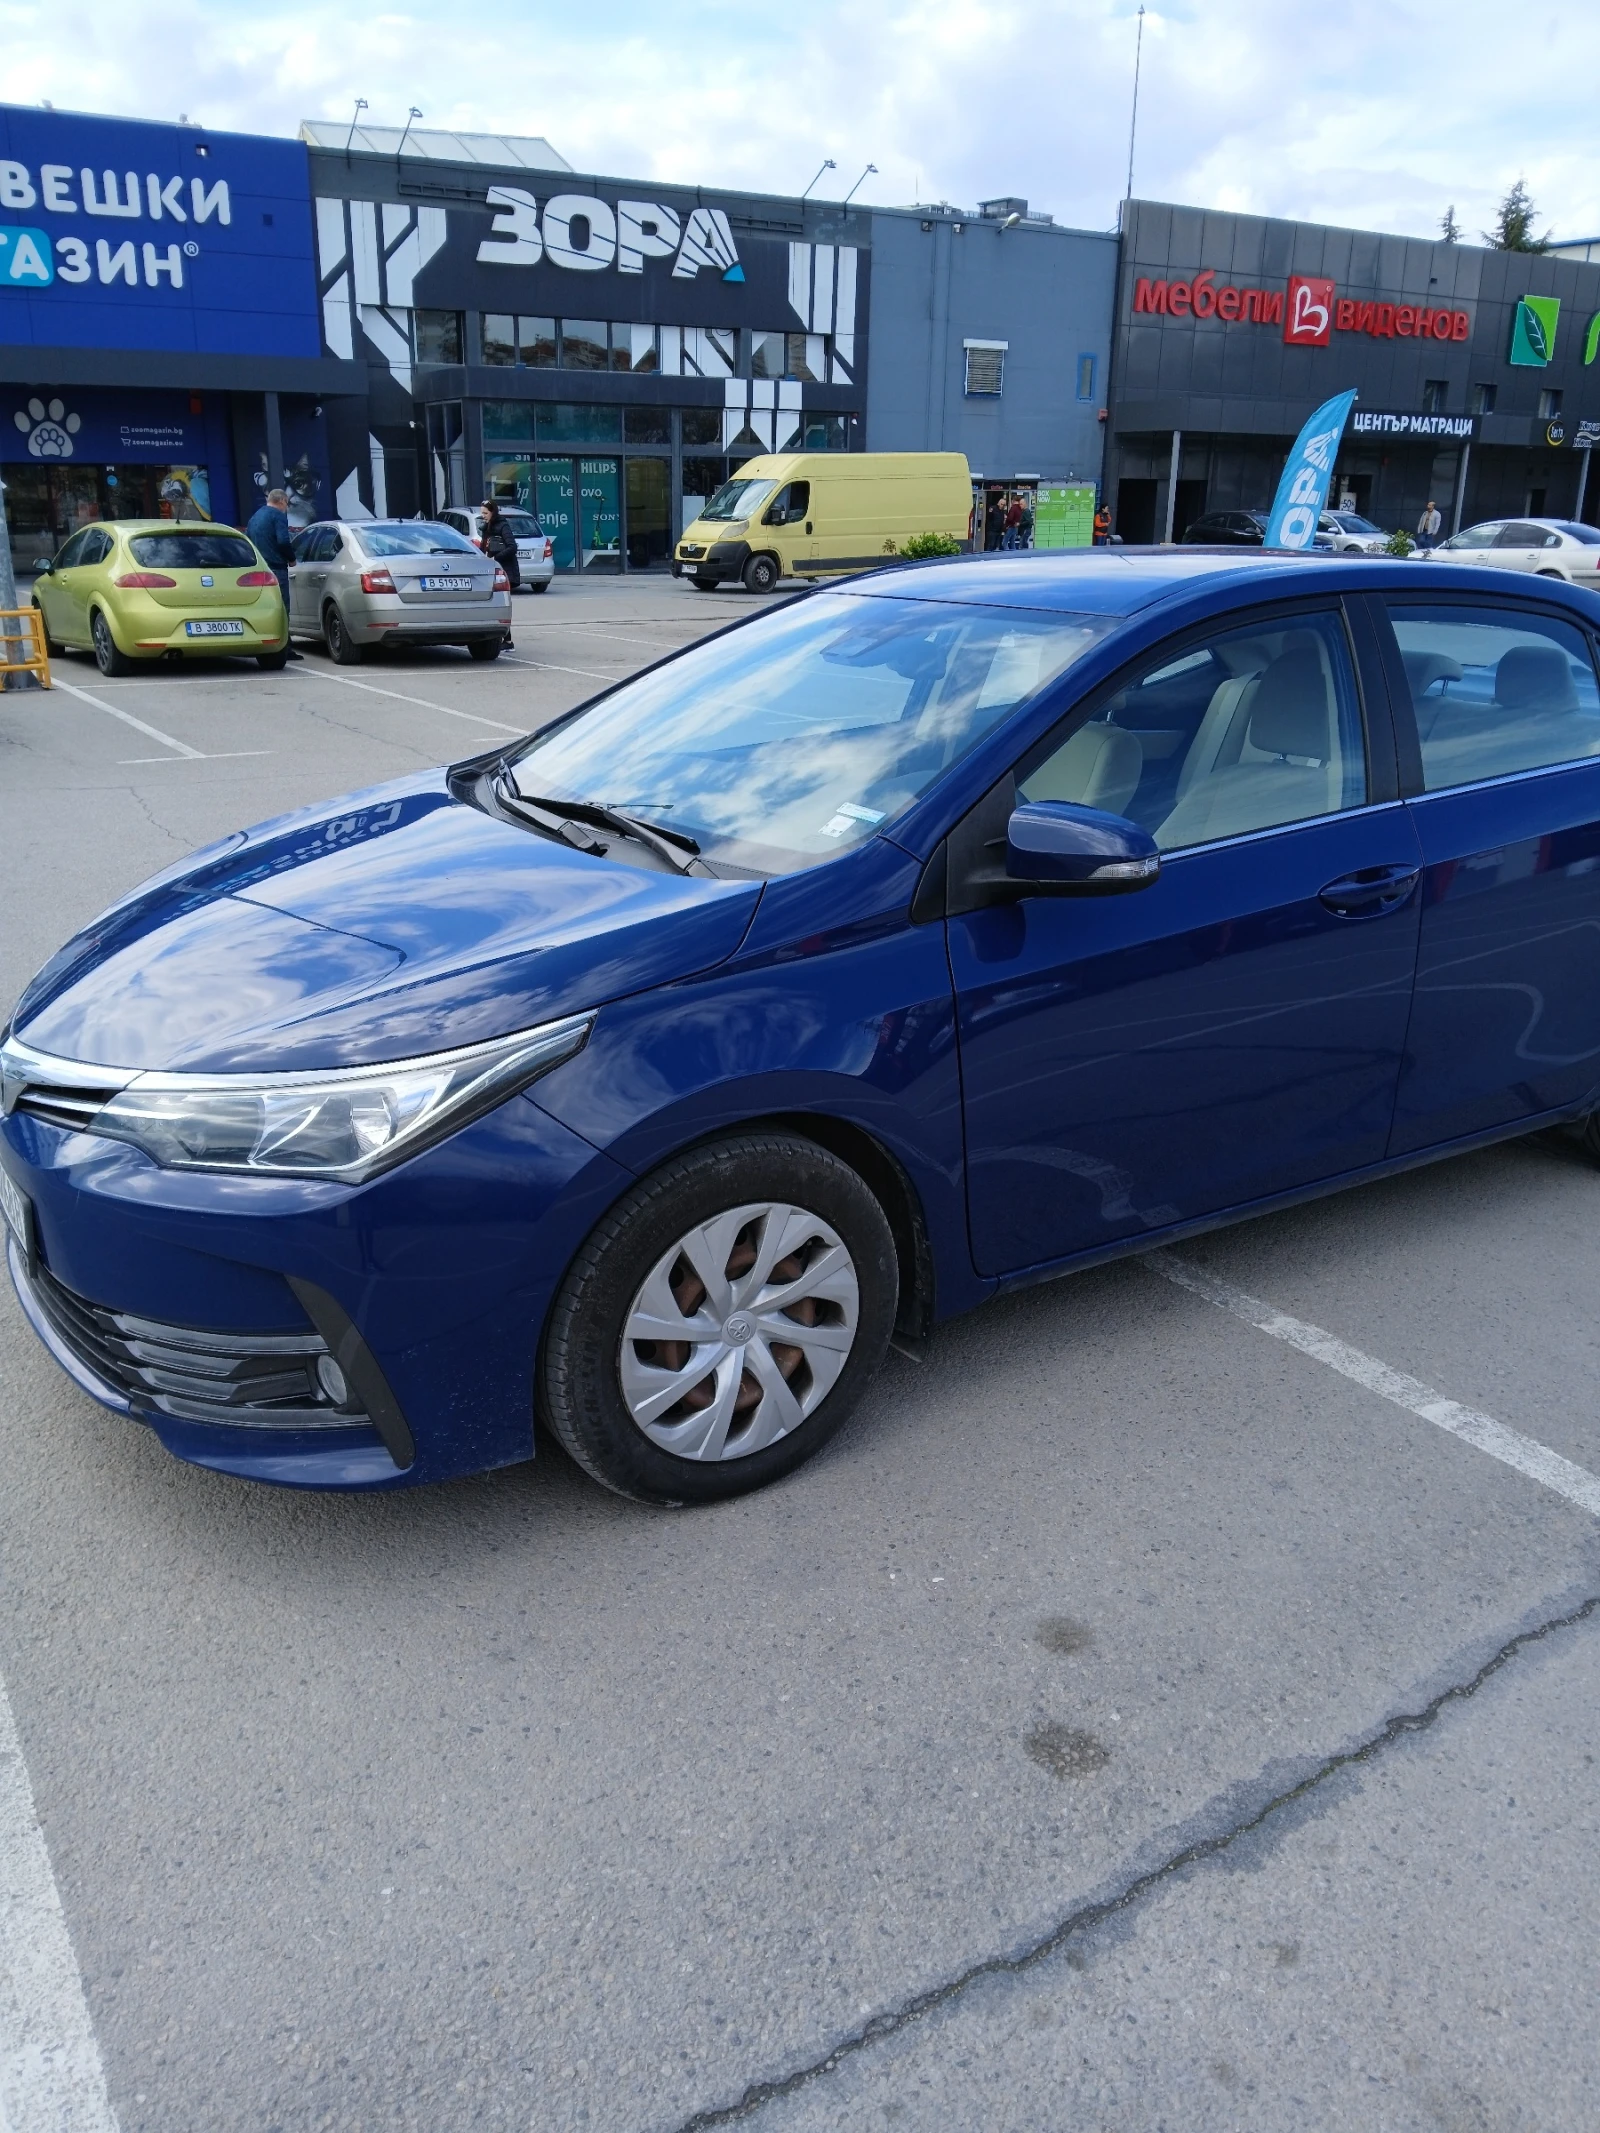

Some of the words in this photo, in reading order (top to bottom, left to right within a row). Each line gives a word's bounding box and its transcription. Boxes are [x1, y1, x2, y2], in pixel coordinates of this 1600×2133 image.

[0, 160, 231, 226] ВЕШКИ
[476, 186, 746, 283] ЗОРА
[1353, 413, 1409, 432] ЦЕНТЪР
[1410, 416, 1473, 437] МАТРАЦИ
[131, 427, 183, 436] zoomagazin.bg
[132, 439, 183, 447] zoomagazin.eu
[581, 462, 617, 474] HILIPS
[560, 486, 602, 497] Leovo
[1280, 427, 1339, 548] ОРА
[428, 578, 436, 588] B
[438, 578, 459, 588] 5193
[195, 623, 202, 633] B
[206, 622, 228, 633] 3800
[228, 622, 241, 632] TK
